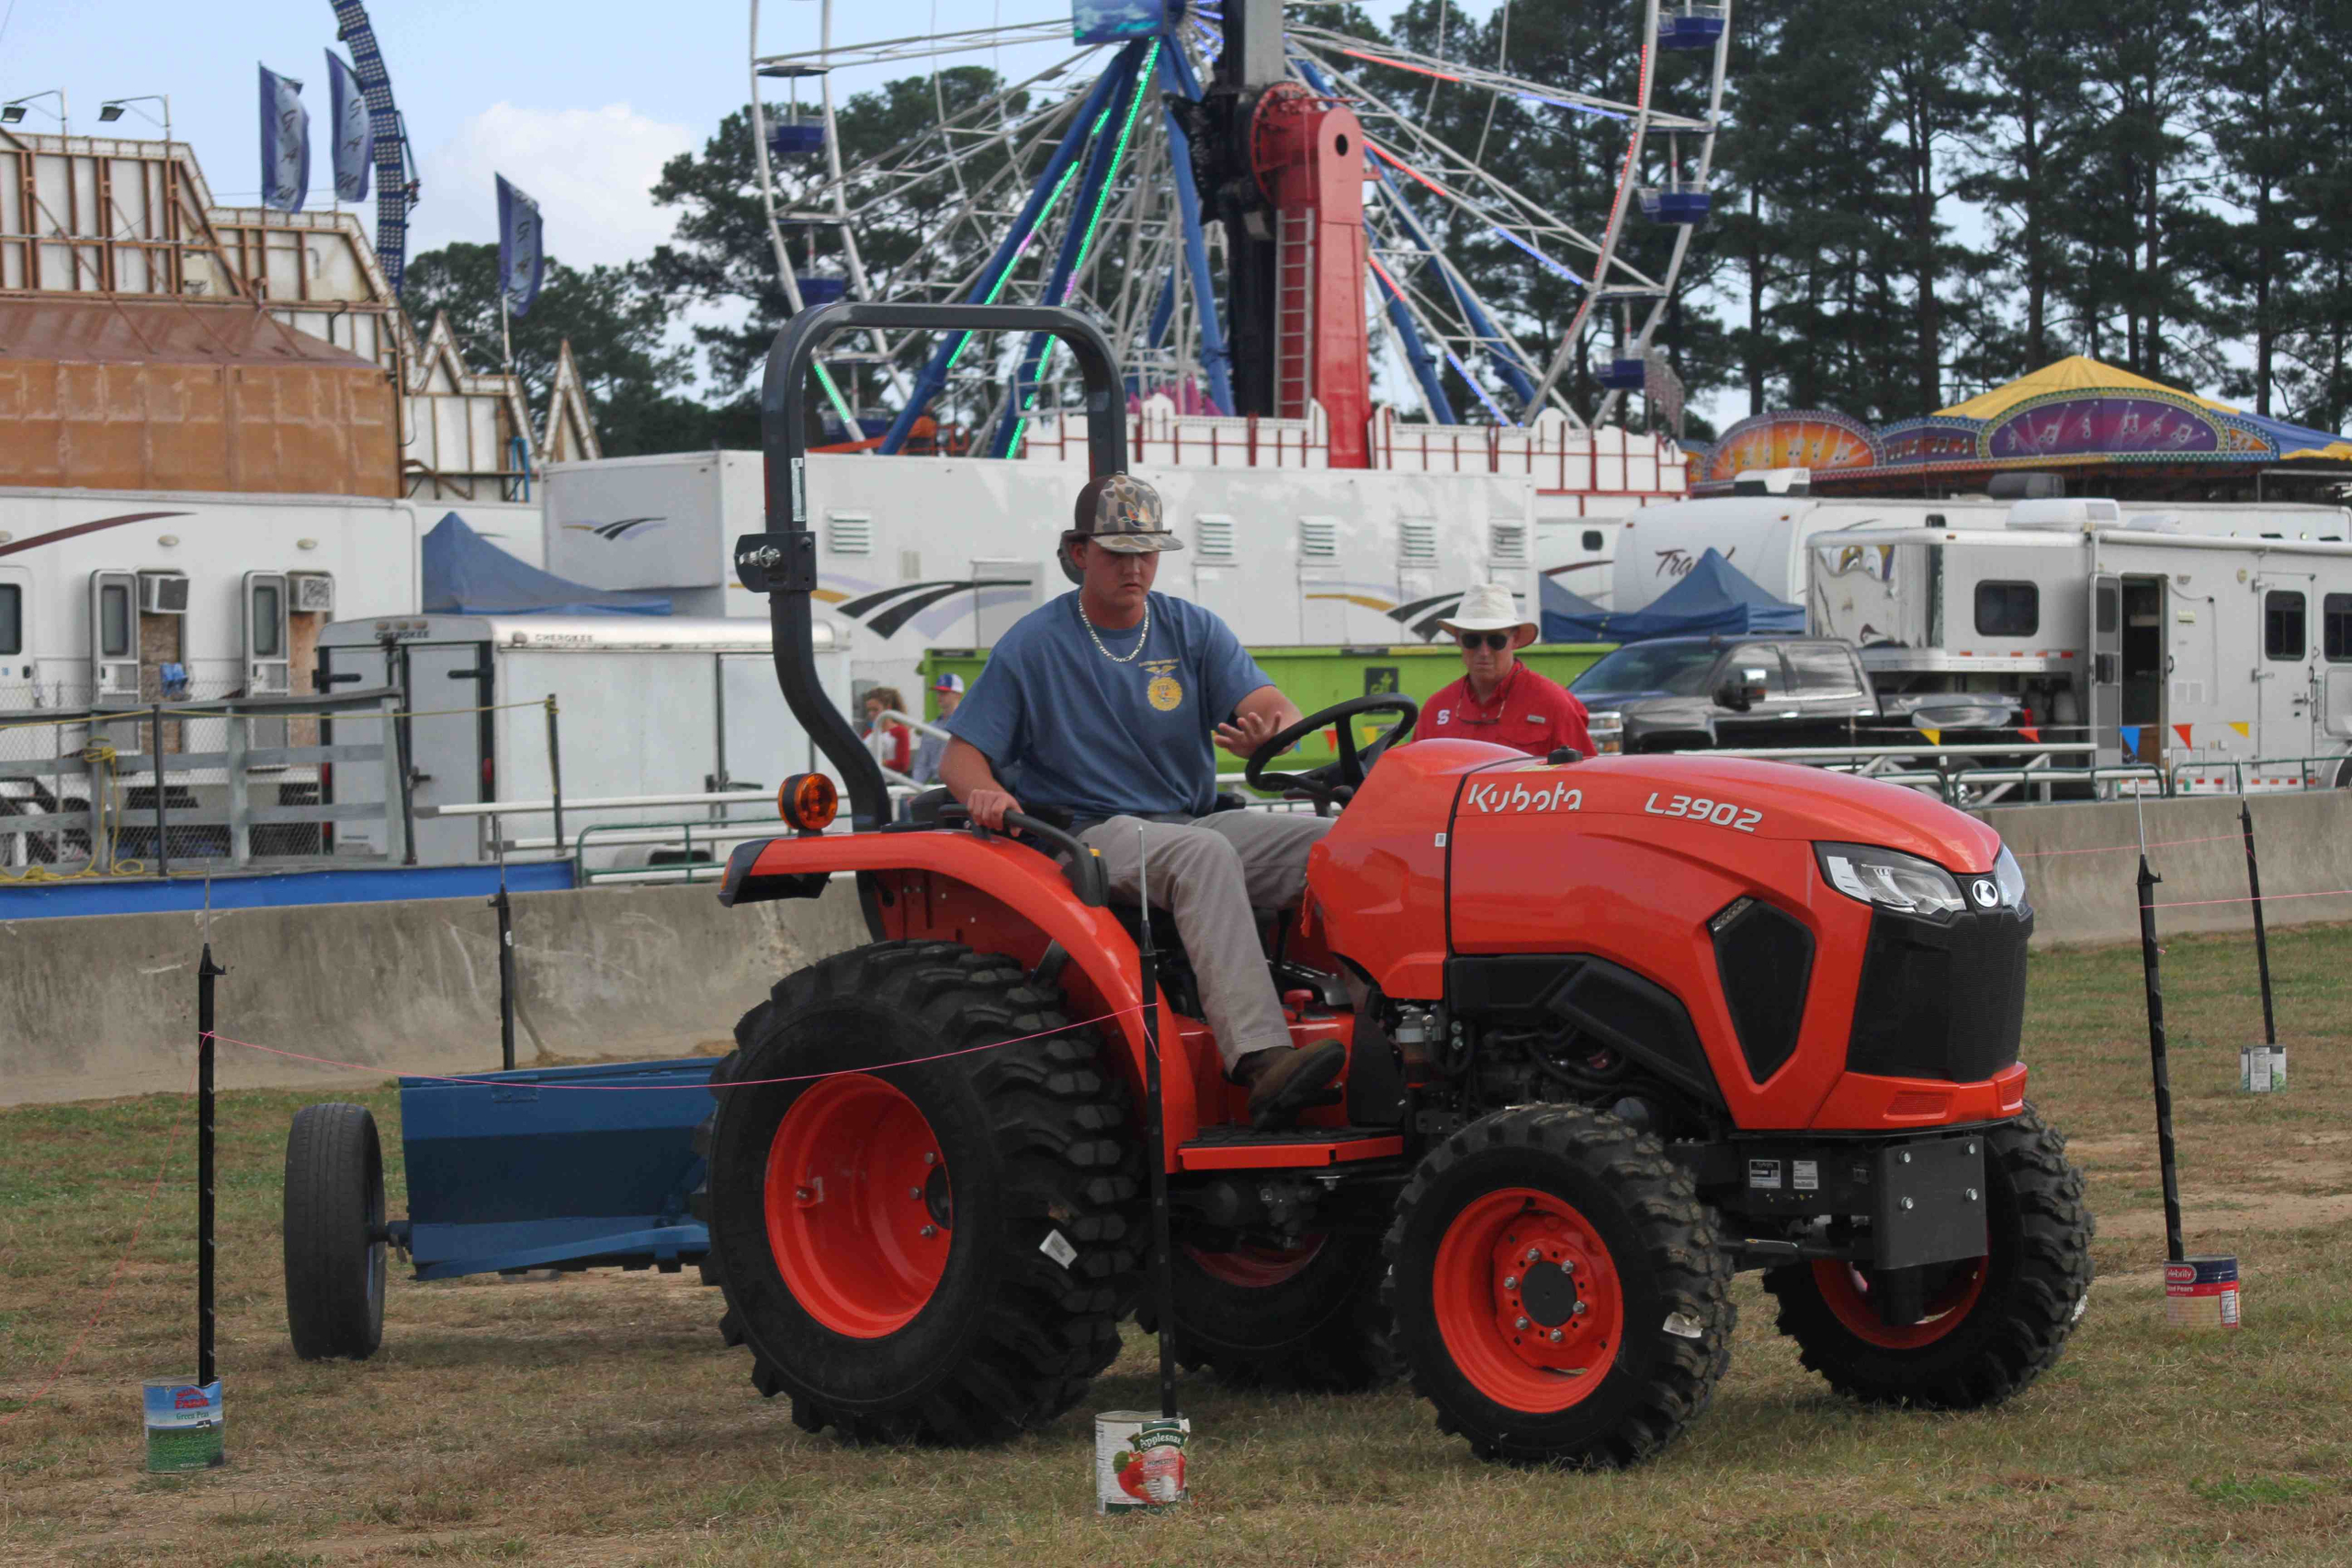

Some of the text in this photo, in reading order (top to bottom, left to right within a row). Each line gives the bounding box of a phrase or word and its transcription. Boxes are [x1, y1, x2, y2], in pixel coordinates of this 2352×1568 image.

[374, 631, 430, 639] CHEROKEE
[535, 634, 594, 642] CHEROKEE
[1437, 709, 1451, 726] S
[1467, 781, 1583, 813] Kubota
[1645, 792, 1763, 832] L3902
[175, 1412, 195, 1420] Green
